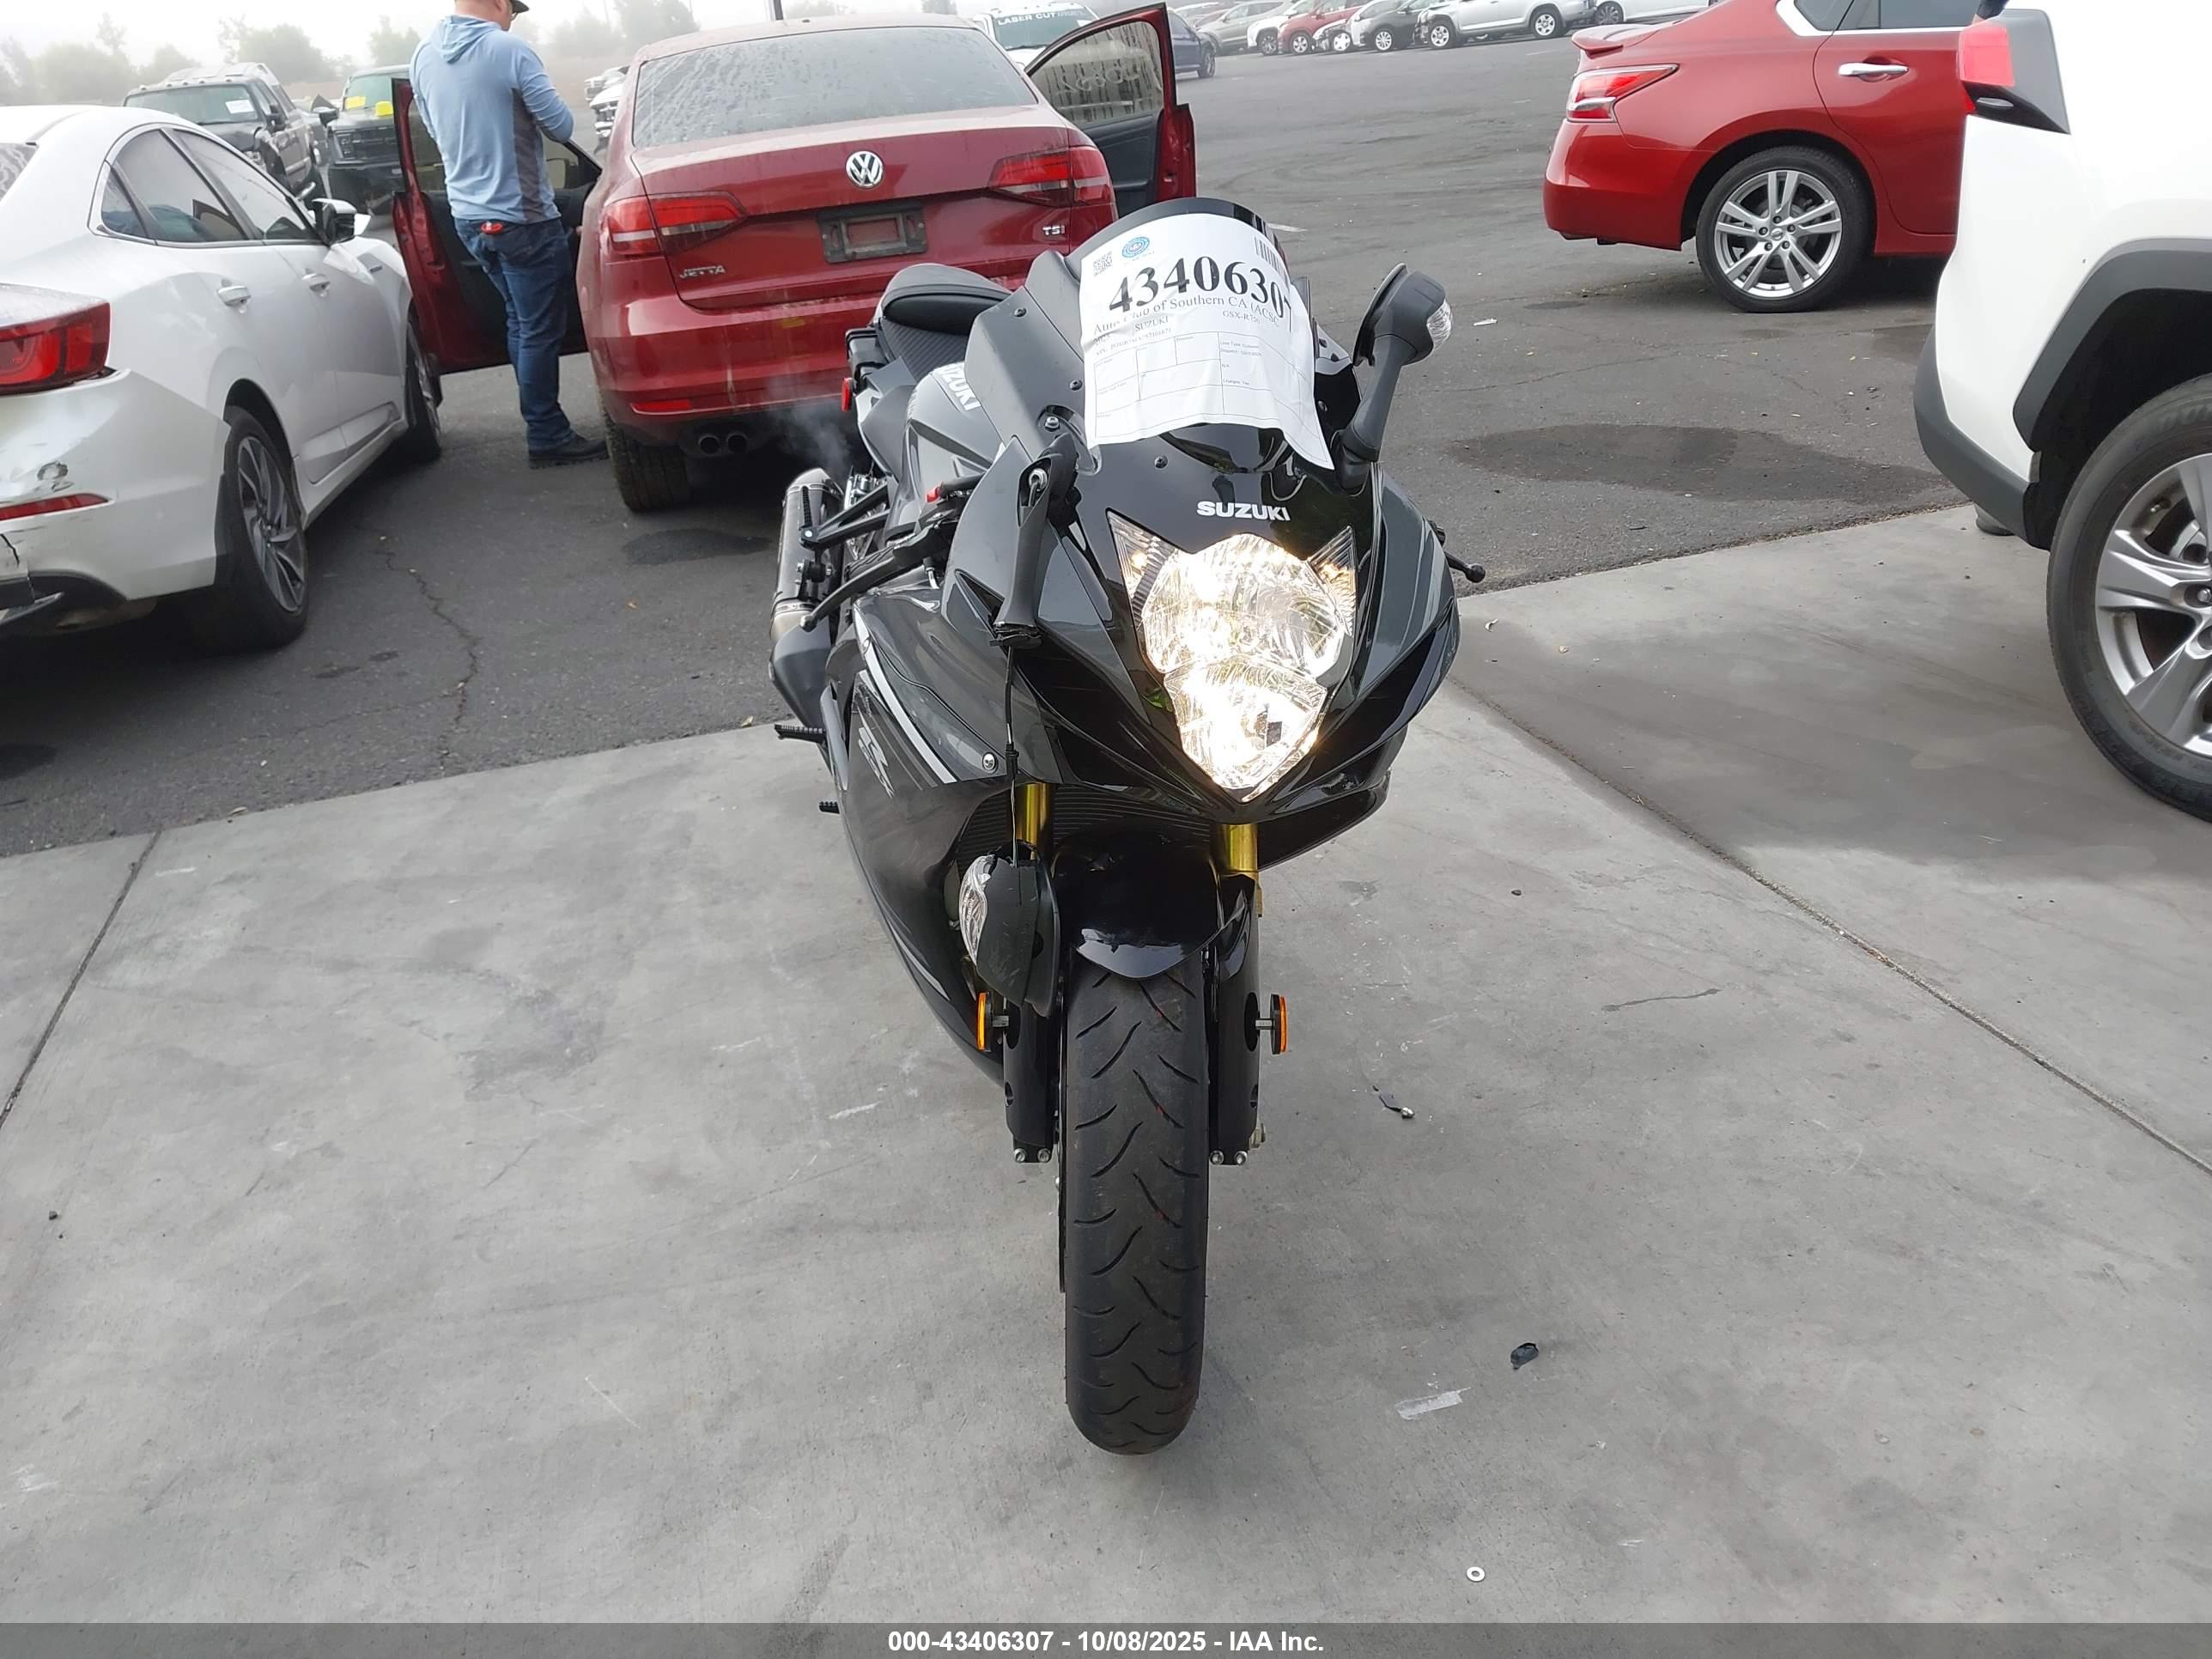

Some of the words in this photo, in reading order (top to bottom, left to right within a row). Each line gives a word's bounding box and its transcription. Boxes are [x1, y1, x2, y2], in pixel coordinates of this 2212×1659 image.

[846, 150, 884, 188] VW
[1042, 225, 1065, 235] TSI
[679, 265, 726, 279] JETTA
[1109, 256, 1291, 333] 43406307
[1153, 301, 1166, 313] of
[1170, 294, 1224, 310] Southern
[1228, 296, 1248, 309] CA
[1134, 315, 1170, 332] SUZUKI
[935, 362, 981, 410] UZUKI
[1196, 501, 1291, 521] SUZUKI
